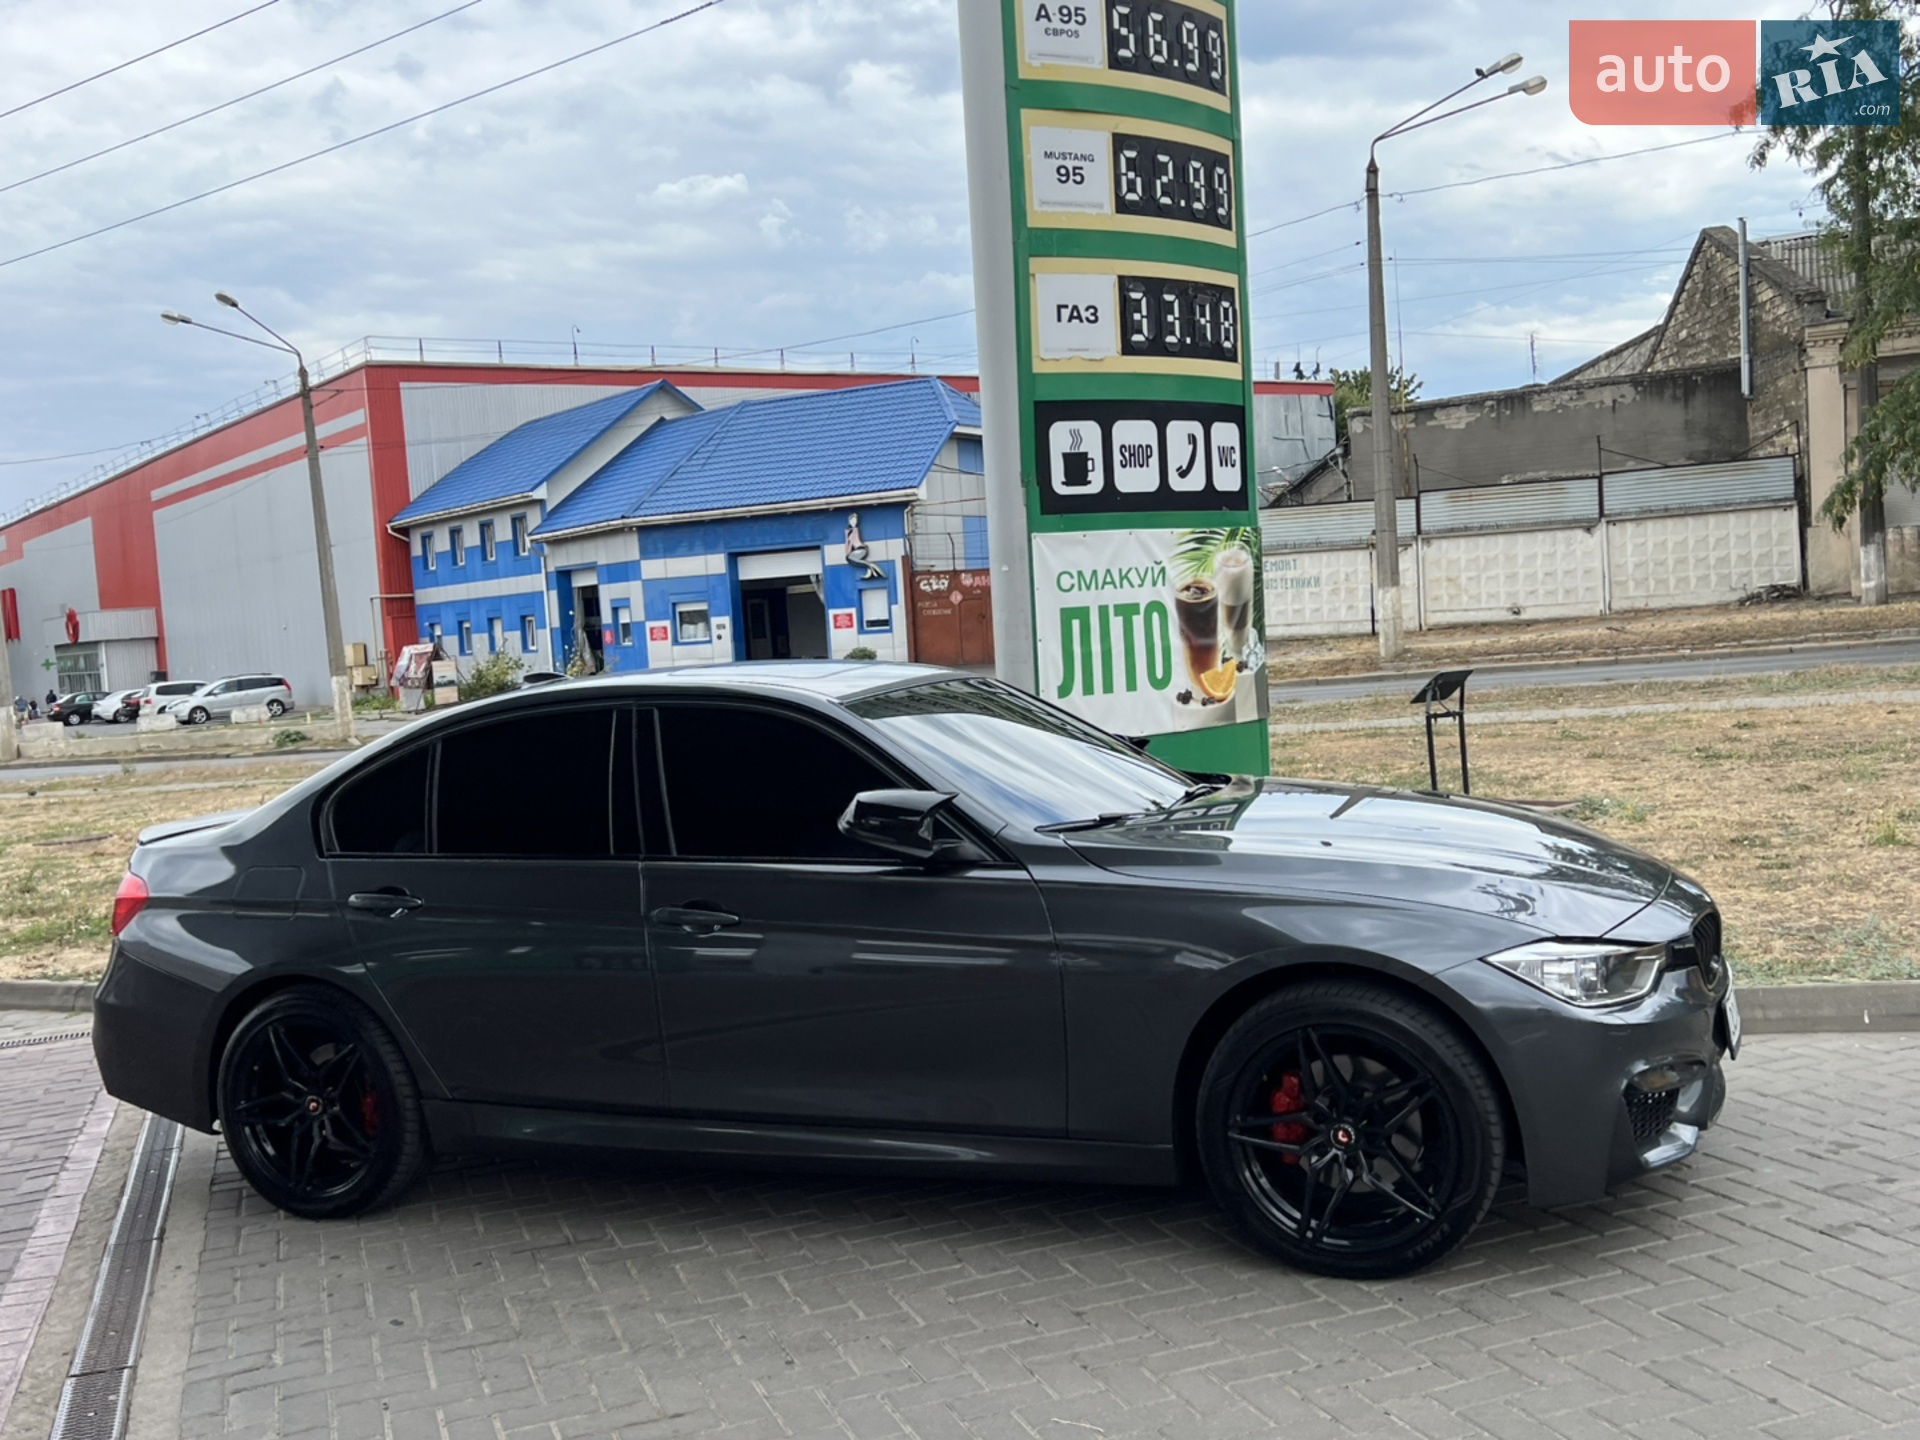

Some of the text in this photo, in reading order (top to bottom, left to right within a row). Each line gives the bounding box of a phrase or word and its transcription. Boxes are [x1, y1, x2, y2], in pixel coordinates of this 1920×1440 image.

[1112, 5, 1222, 80] 56.99
[1044, 150, 1095, 163] MUSTANG
[1056, 165, 1085, 185] 95
[1120, 149, 1229, 216] 62.99
[1056, 304, 1100, 324] ГАЗ
[1128, 291, 1235, 349] 33.48
[1119, 444, 1153, 469] SHOP
[1217, 445, 1237, 468] WC
[1056, 560, 1167, 593] СМАКУЙ
[1263, 558, 1297, 573] ЕМОНТ
[1057, 600, 1173, 699] ЛІТО
